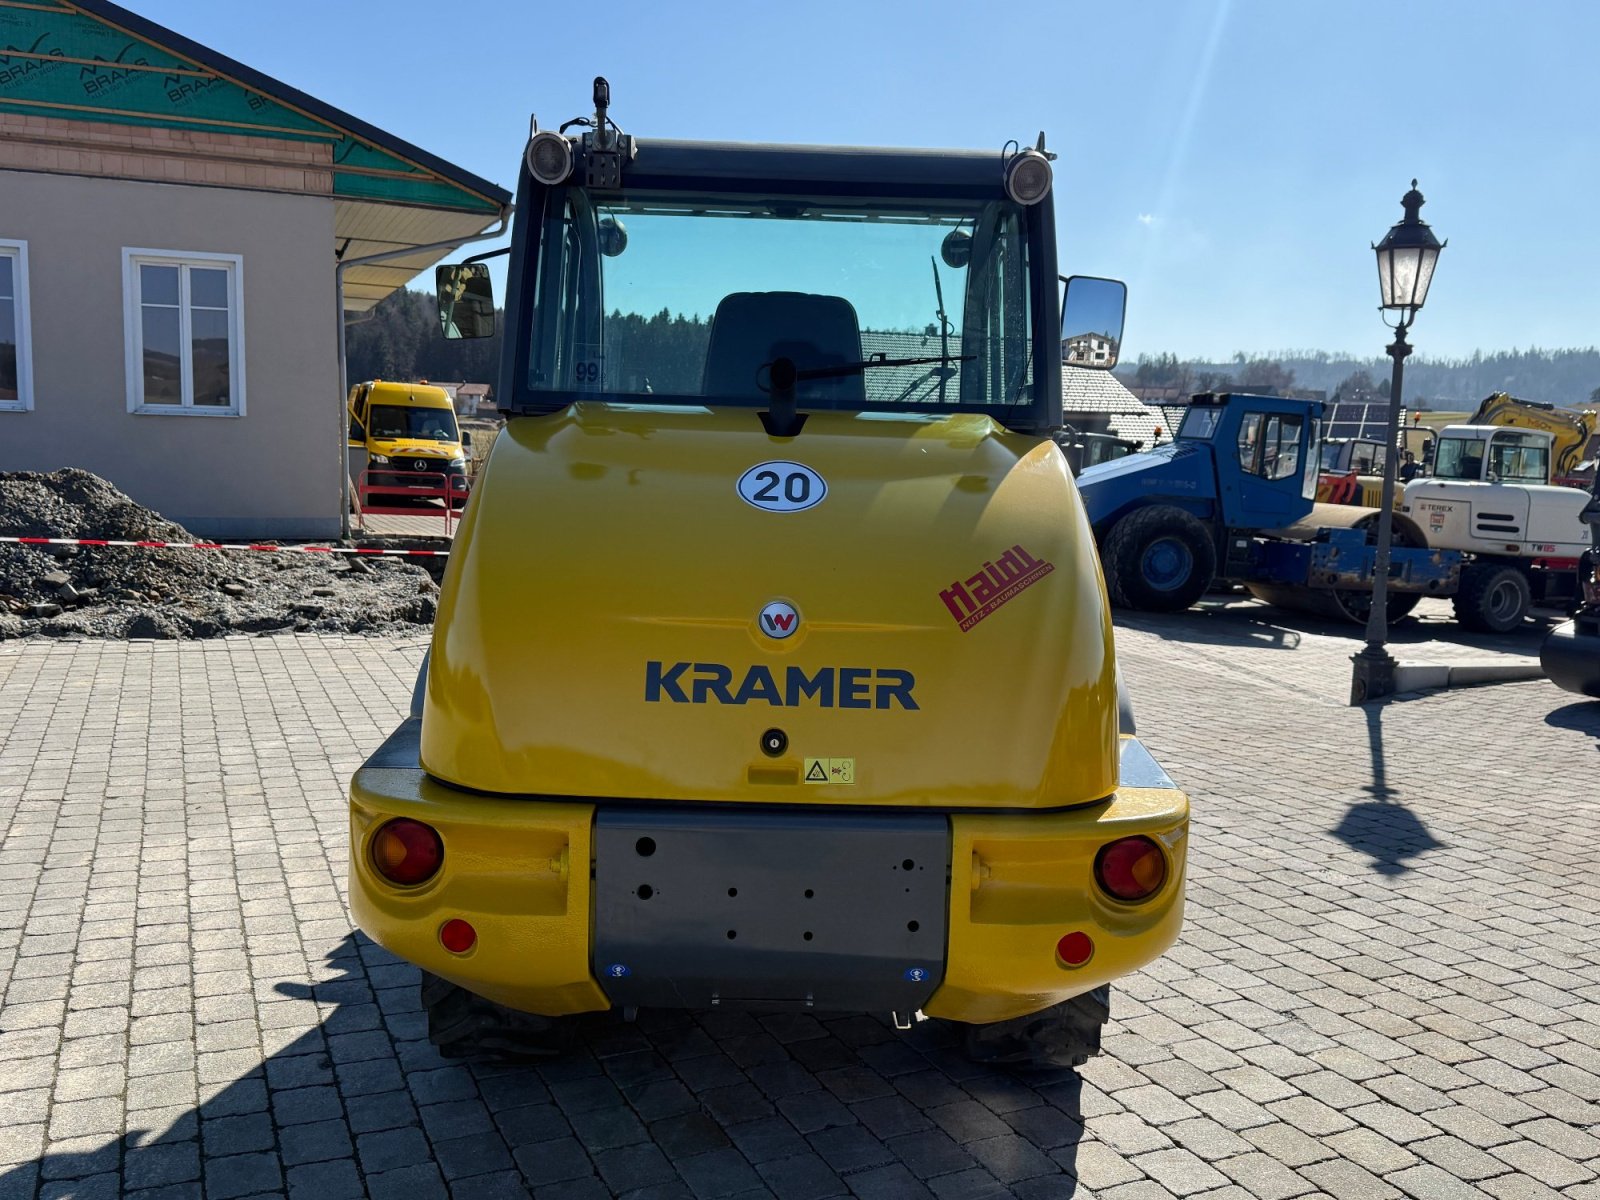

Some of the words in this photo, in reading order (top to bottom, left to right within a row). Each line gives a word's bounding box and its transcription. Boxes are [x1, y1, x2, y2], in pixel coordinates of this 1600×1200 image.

[167, 76, 223, 103] BRAA
[576, 362, 598, 382] 99
[753, 470, 811, 503] 20
[1428, 504, 1454, 512] TEREX
[939, 544, 1047, 624] Haidl
[961, 609, 987, 631] NUTZ
[990, 563, 1054, 610] BAUMASCHINEN
[644, 661, 921, 711] KRAMER
